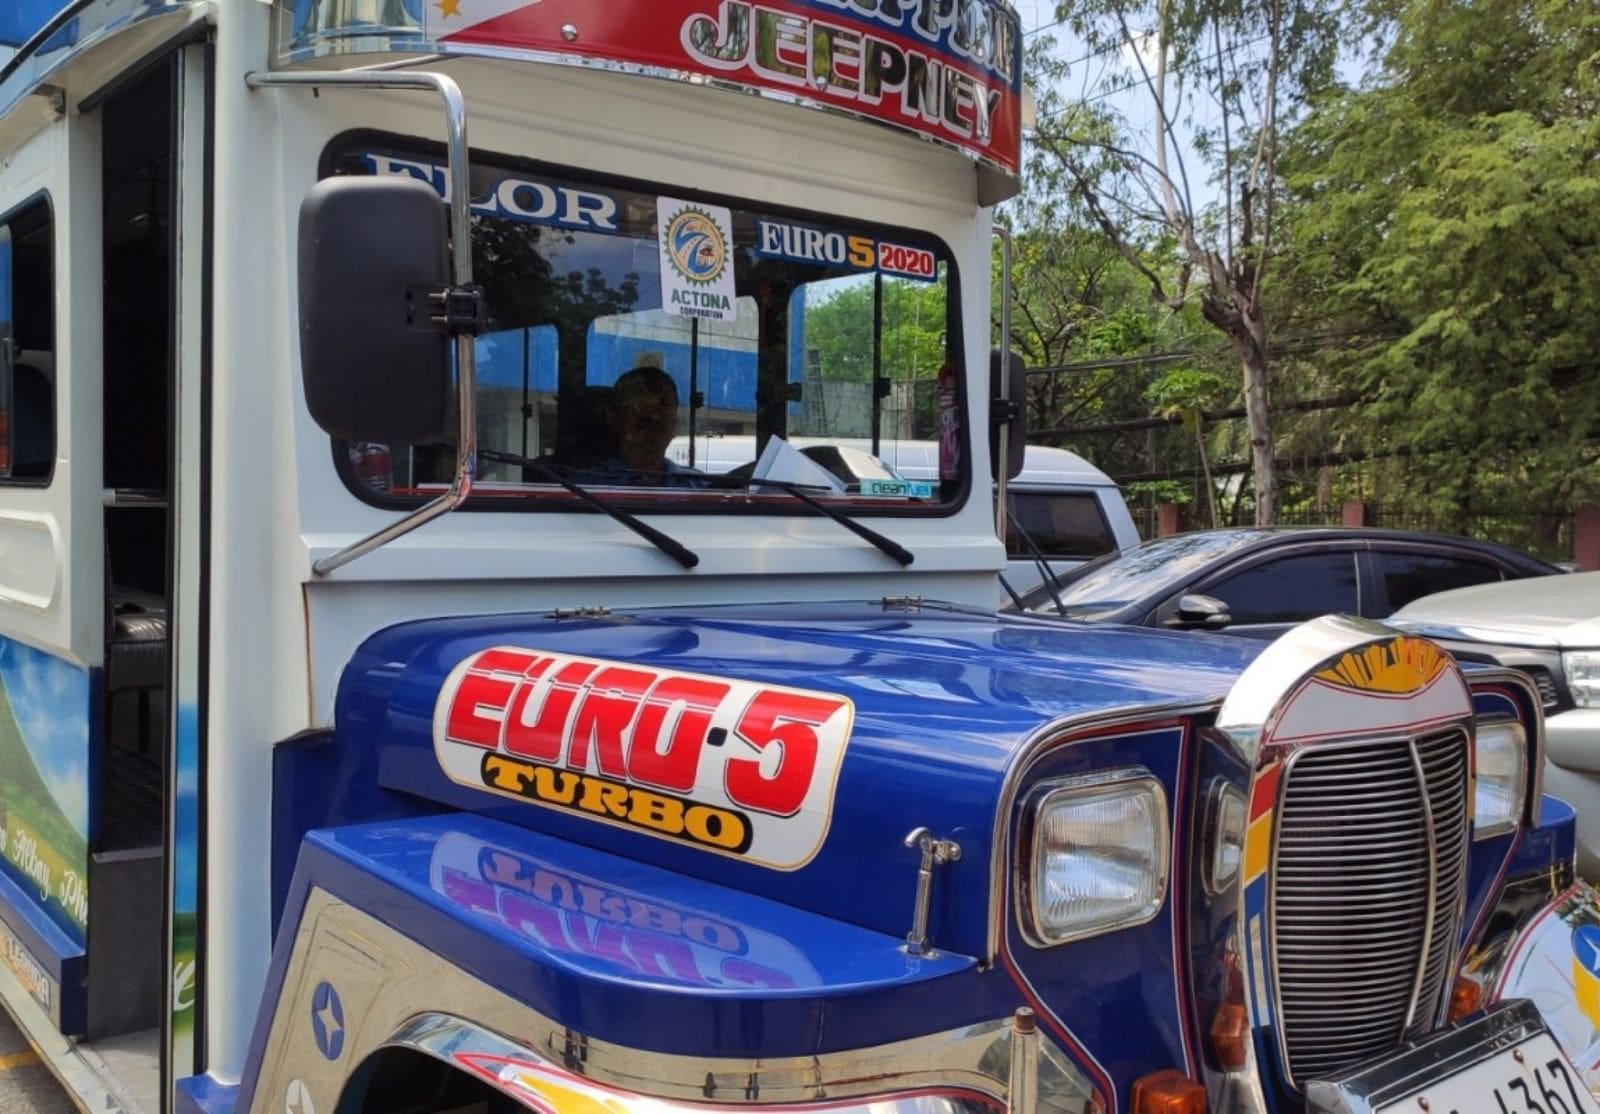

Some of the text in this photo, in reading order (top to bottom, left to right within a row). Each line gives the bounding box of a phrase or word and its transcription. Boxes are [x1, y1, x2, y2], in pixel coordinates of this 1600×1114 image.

[680, 2, 999, 145] JEEPNEY
[879, 243, 935, 277] 2020
[671, 288, 731, 311] ACTONA
[680, 306, 724, 321] CORPORATION
[485, 759, 745, 850] TURBO
